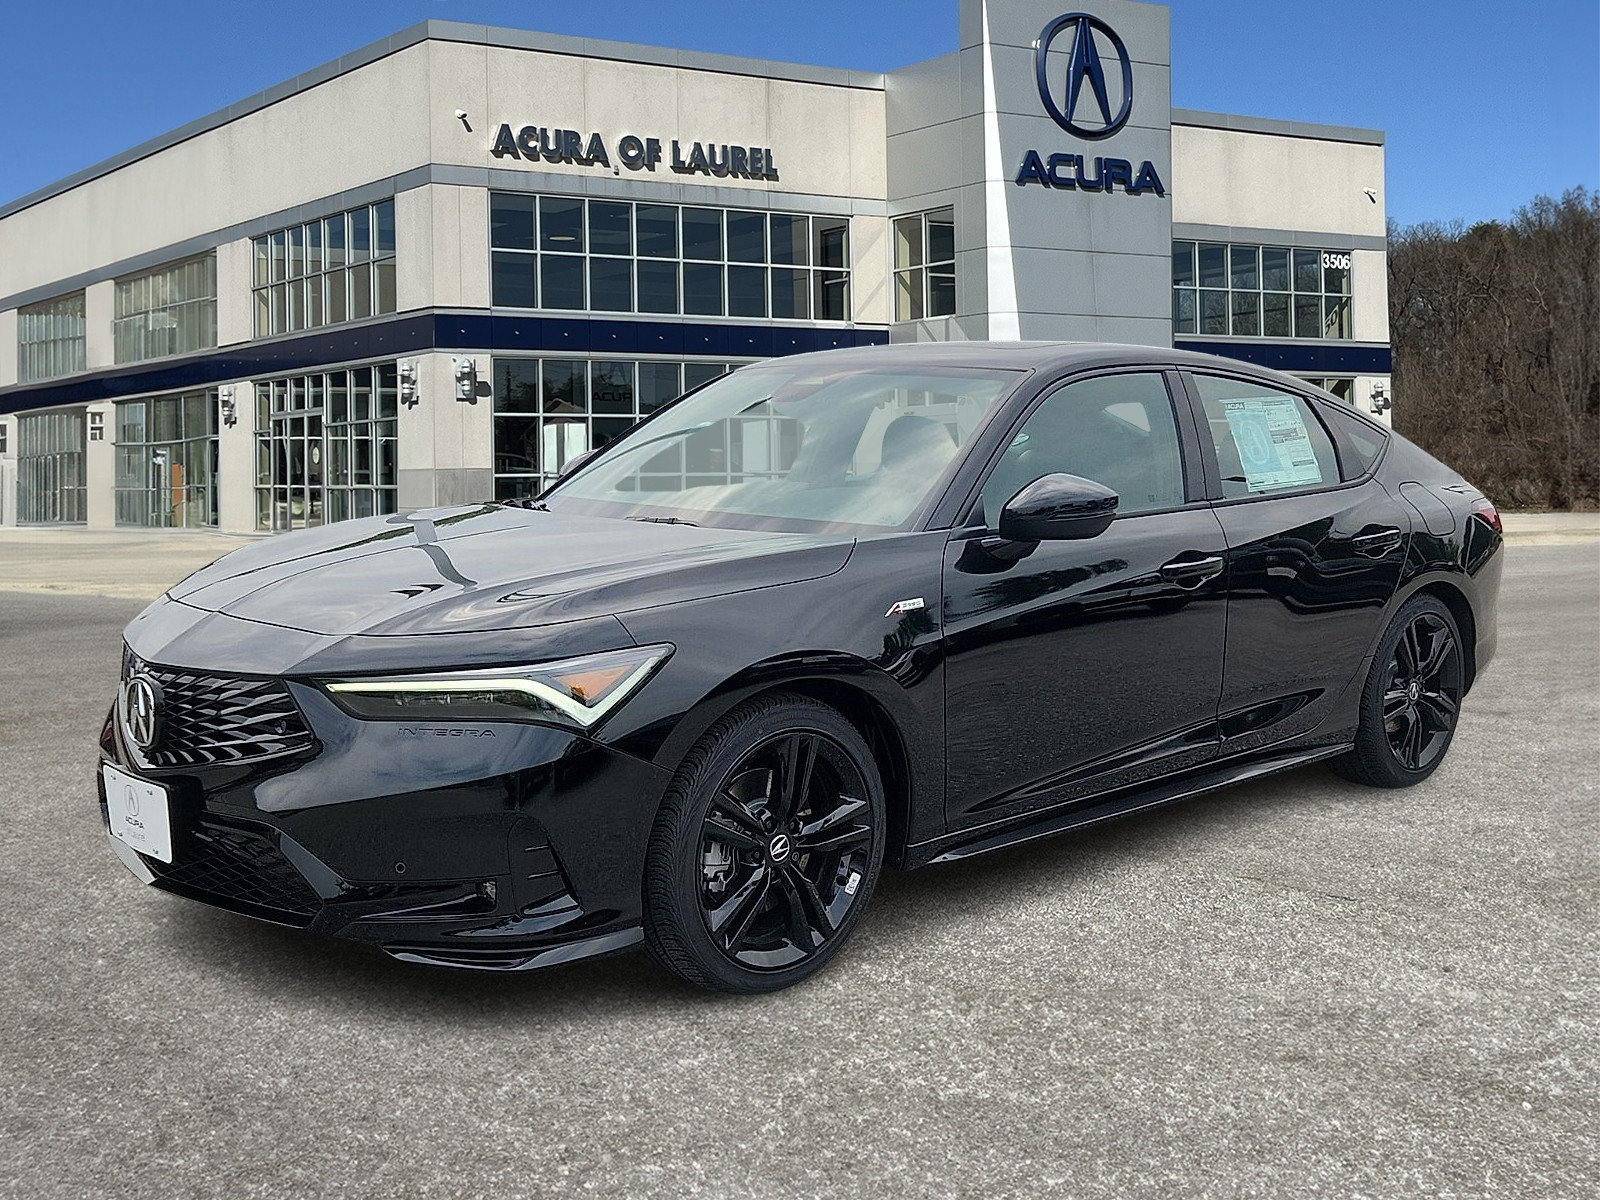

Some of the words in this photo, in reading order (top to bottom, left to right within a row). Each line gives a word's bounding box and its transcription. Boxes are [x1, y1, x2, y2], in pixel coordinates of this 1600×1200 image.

[490, 123, 611, 168] ACURA
[618, 135, 662, 171] OF
[670, 140, 779, 182] LAUREL
[1015, 149, 1165, 198] ACURA
[1322, 253, 1351, 270] 3506
[397, 727, 496, 738] INTEGRA
